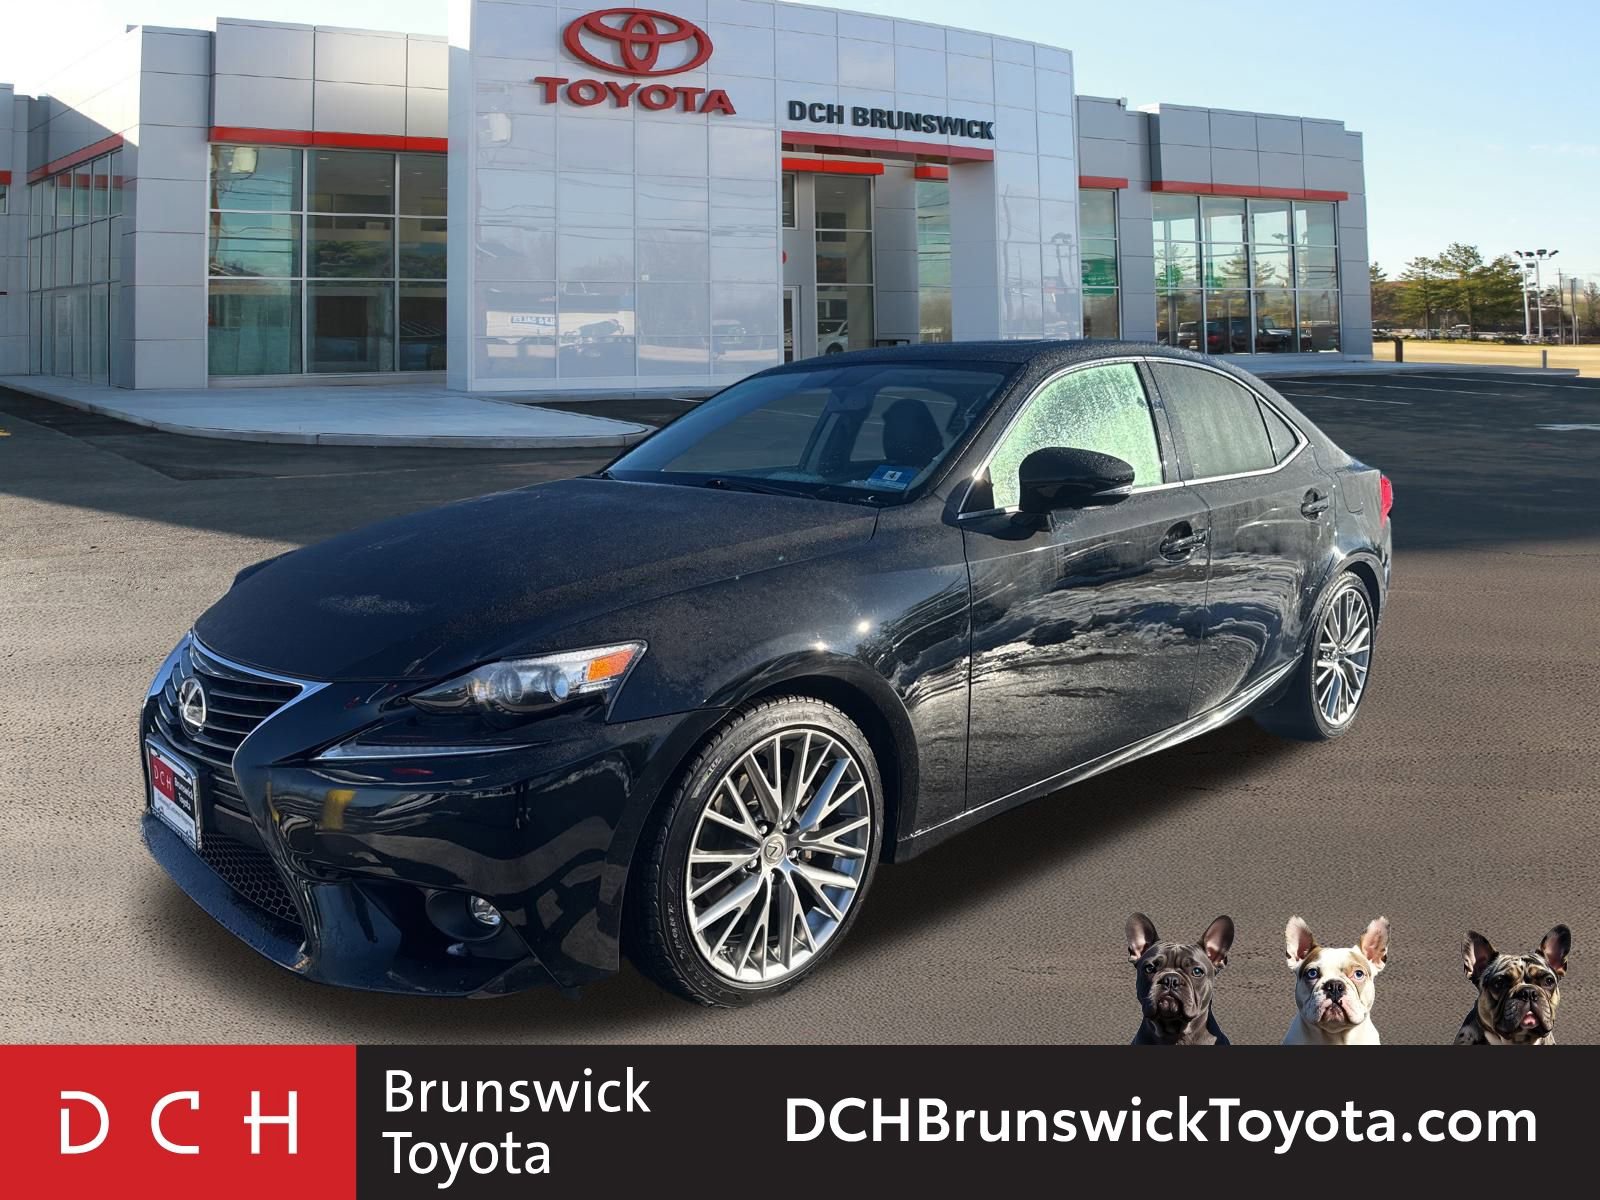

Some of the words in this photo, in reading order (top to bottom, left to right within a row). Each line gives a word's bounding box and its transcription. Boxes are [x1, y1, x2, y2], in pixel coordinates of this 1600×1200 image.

[535, 76, 736, 115] TOYOTA
[788, 100, 845, 125] DCH
[852, 106, 995, 140] BRUNSWICK
[153, 765, 173, 792] DCH
